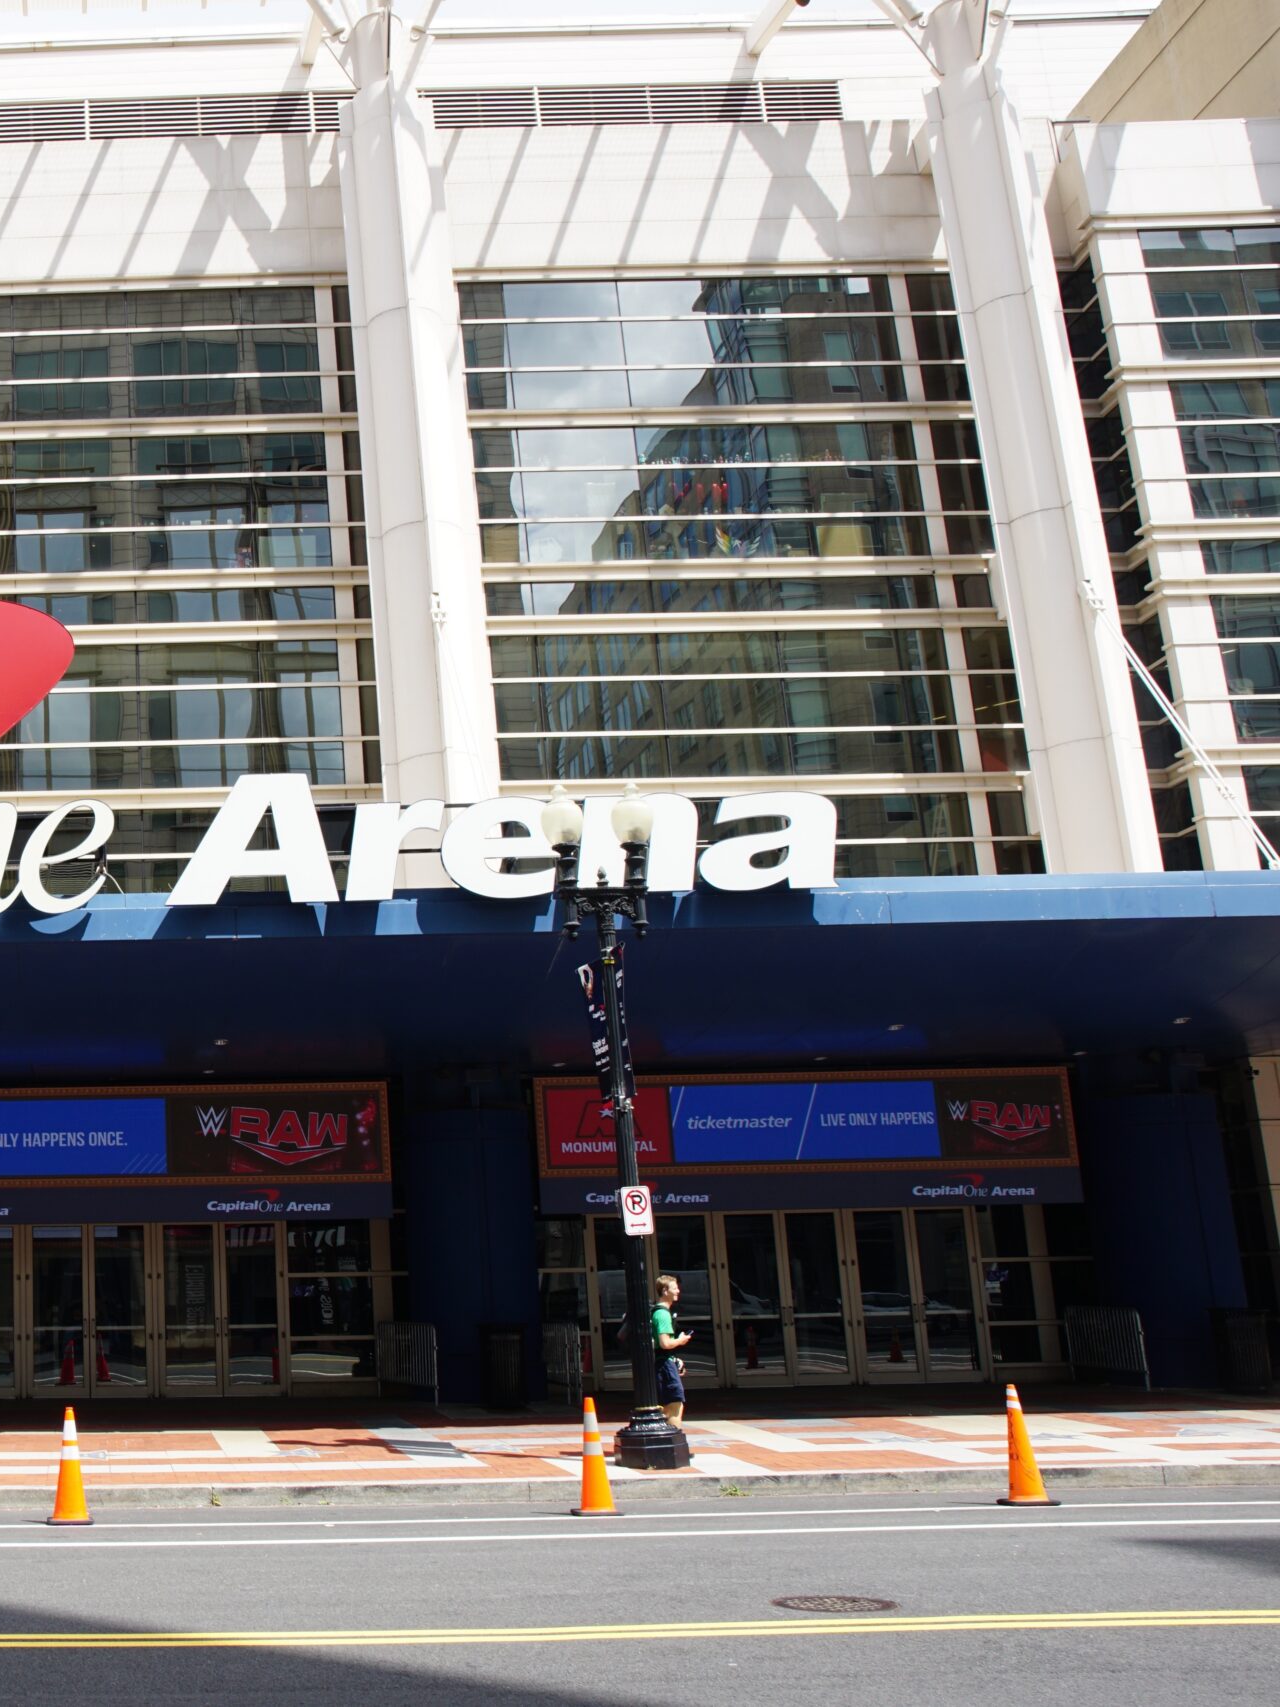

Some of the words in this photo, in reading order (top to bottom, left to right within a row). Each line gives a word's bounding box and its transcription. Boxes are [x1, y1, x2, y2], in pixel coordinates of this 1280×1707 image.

[166, 773, 839, 906] Arena
[820, 1113, 846, 1127] LIVE
[849, 1113, 877, 1126] ONLY
[881, 1111, 934, 1126] HAPPENS
[971, 1100, 1051, 1129] RAW
[230, 1106, 348, 1149] RAW
[687, 1115, 793, 1130] ticketmaster
[23, 1132, 85, 1147] HAPPENS
[88, 1131, 128, 1147] ONCE.
[561, 1140, 657, 1153] MONUMTAL
[664, 1193, 709, 1204] Arena
[991, 1186, 1035, 1196] Arena
[286, 1201, 332, 1213] Arena
